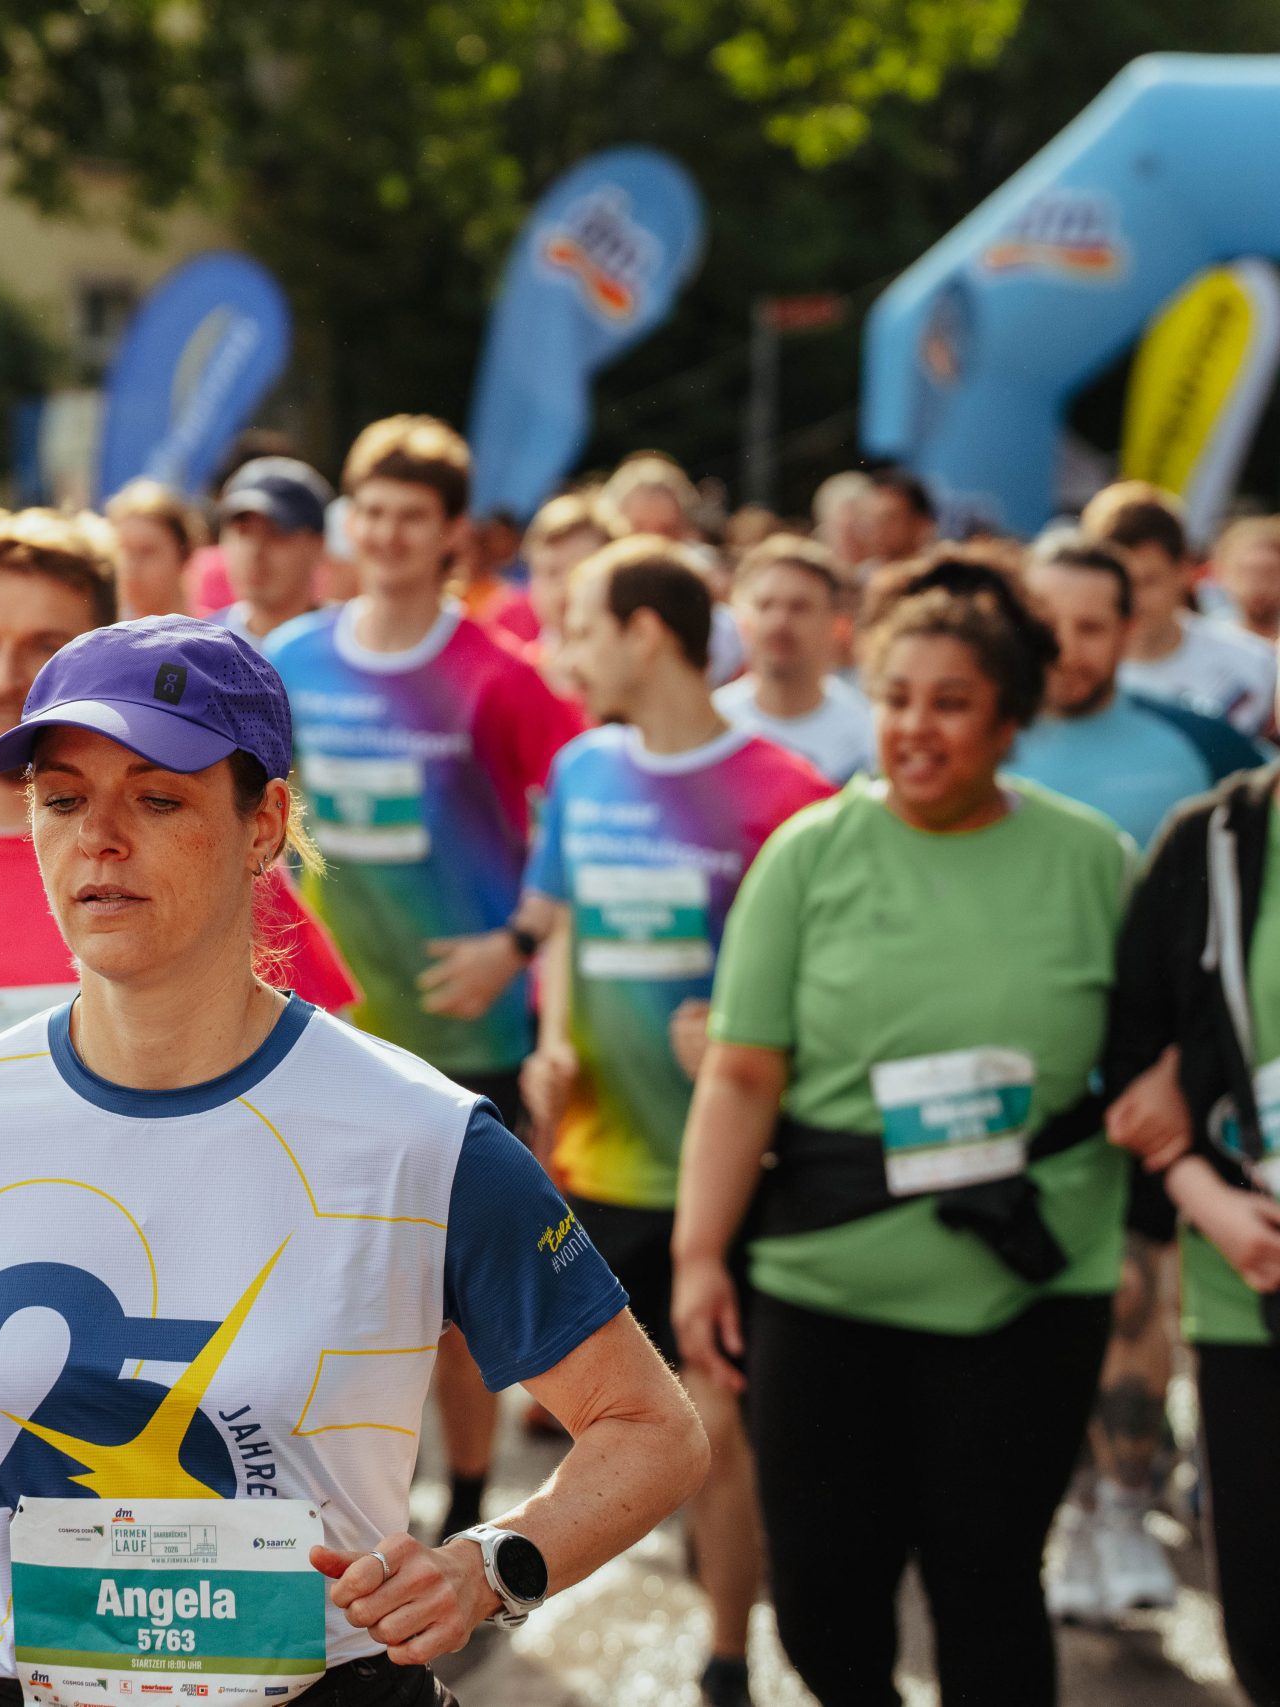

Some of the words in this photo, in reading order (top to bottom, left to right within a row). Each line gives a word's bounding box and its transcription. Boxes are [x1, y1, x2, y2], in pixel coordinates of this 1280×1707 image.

[218, 1404, 277, 1497] JAHRE
[115, 1507, 133, 1518] dm
[114, 1528, 147, 1538] FIRMEN
[115, 1540, 147, 1553] LAUF
[96, 1578, 237, 1627] Angela
[137, 1628, 196, 1652] 5763
[131, 1658, 167, 1669] STARTZEIT
[167, 1659, 186, 1669] 18:00
[187, 1660, 202, 1670] UHR
[31, 1669, 49, 1682] dm
